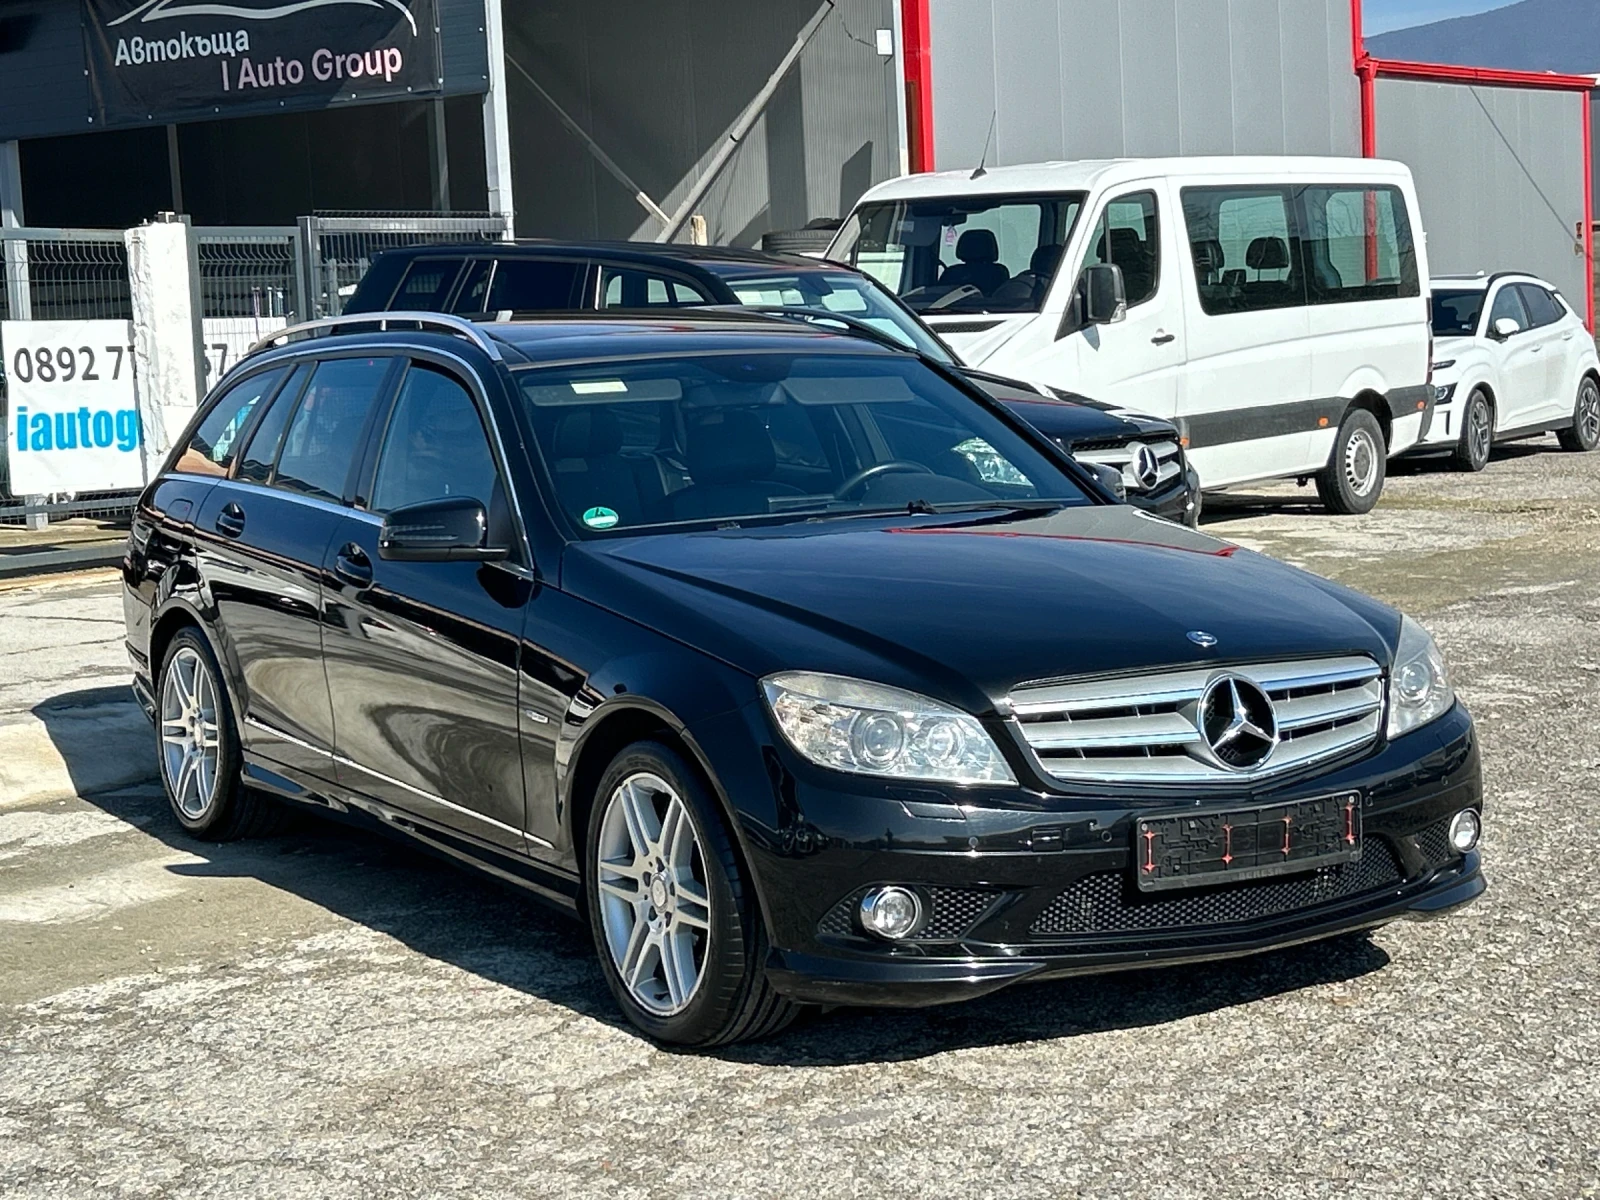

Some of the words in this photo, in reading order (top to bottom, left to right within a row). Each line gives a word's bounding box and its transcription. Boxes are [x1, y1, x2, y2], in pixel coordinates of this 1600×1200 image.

[114, 29, 250, 67] Автокъща
[237, 56, 304, 90] Auto
[311, 47, 403, 83] Group
[13, 346, 99, 383] 0892
